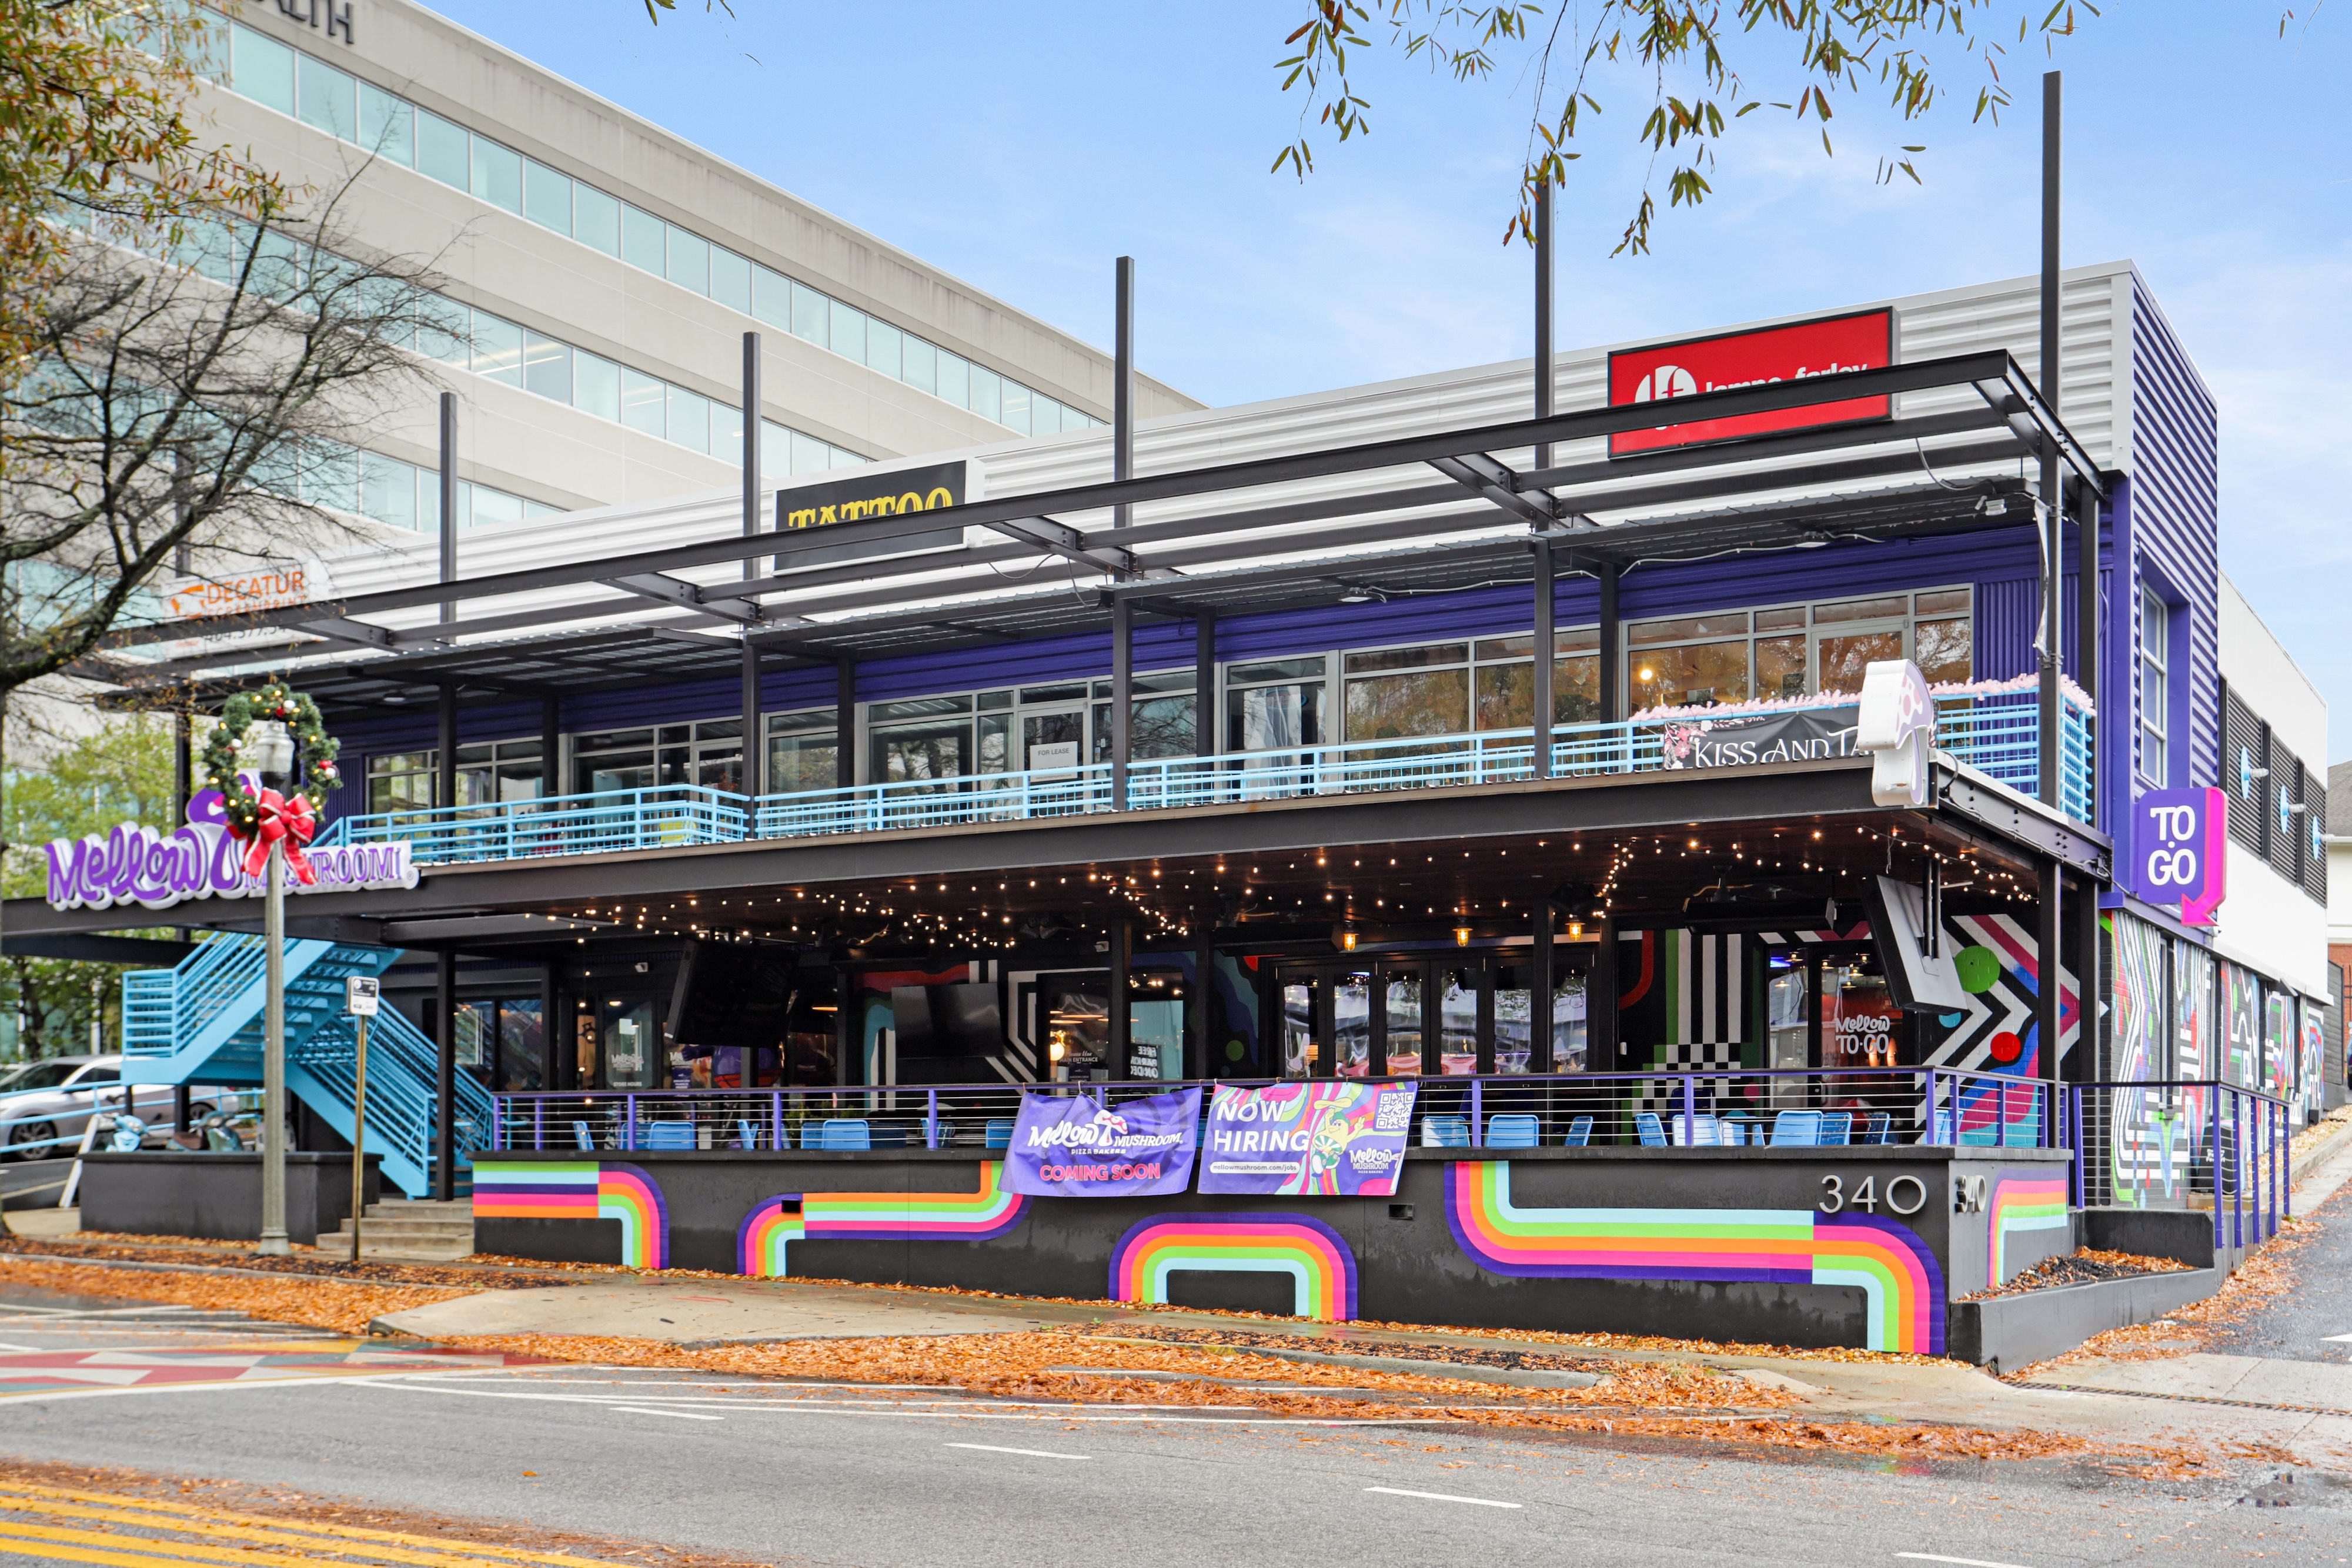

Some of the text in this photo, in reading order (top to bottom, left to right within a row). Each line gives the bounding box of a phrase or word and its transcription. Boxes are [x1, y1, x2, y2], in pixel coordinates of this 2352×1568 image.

[208, 571, 305, 604] DECATUR
[1695, 741, 1757, 767] KISS
[1760, 738, 1830, 763] AND
[2150, 805, 2196, 841] TO
[44, 825, 202, 901] Mellow
[2148, 848, 2197, 886] GO
[1835, 1014, 1890, 1033] Mellow
[1217, 1100, 1287, 1122] NOW
[1114, 1132, 1182, 1147] MUSHROOM
[1213, 1129, 1311, 1152] HIRING
[1349, 1148, 1392, 1164] Mellow
[1040, 1163, 1161, 1181] COMING SOON
[1819, 1175, 1927, 1215] 340
[1955, 1175, 1987, 1213] 340
